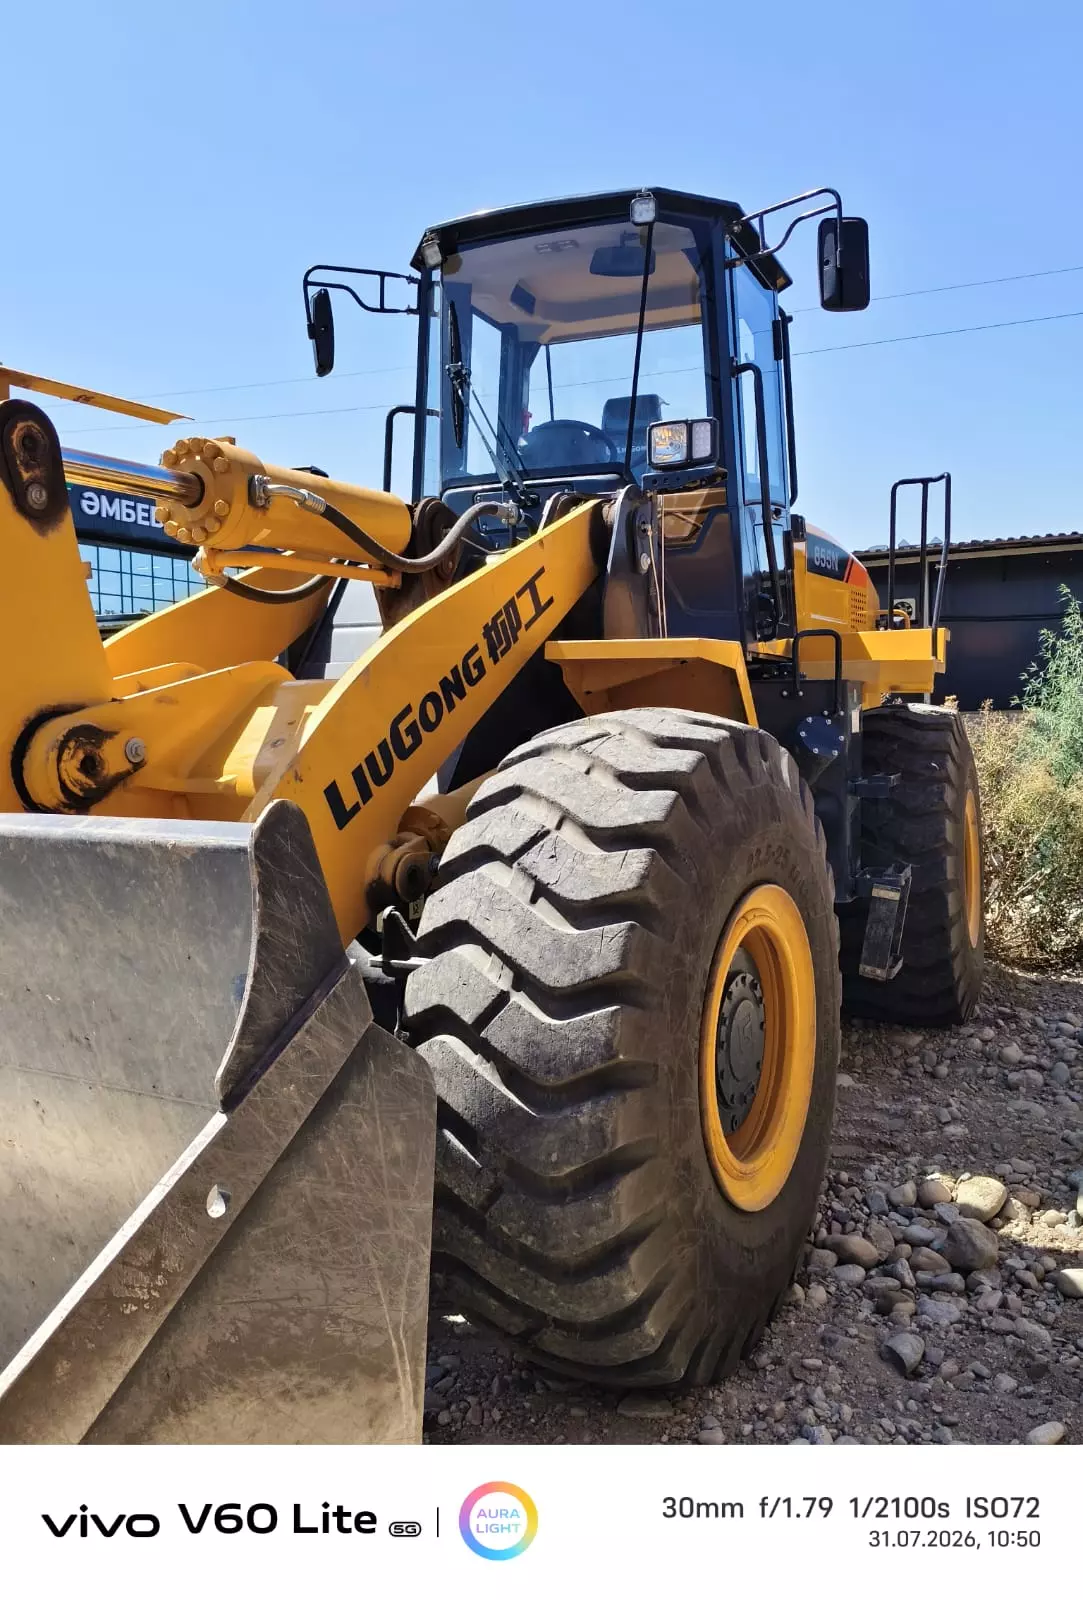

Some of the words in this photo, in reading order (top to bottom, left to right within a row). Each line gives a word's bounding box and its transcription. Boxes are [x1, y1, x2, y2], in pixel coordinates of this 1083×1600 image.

[813, 545, 840, 572] 855N
[323, 643, 487, 831] LIUGONG
[482, 565, 554, 665] 柳工
